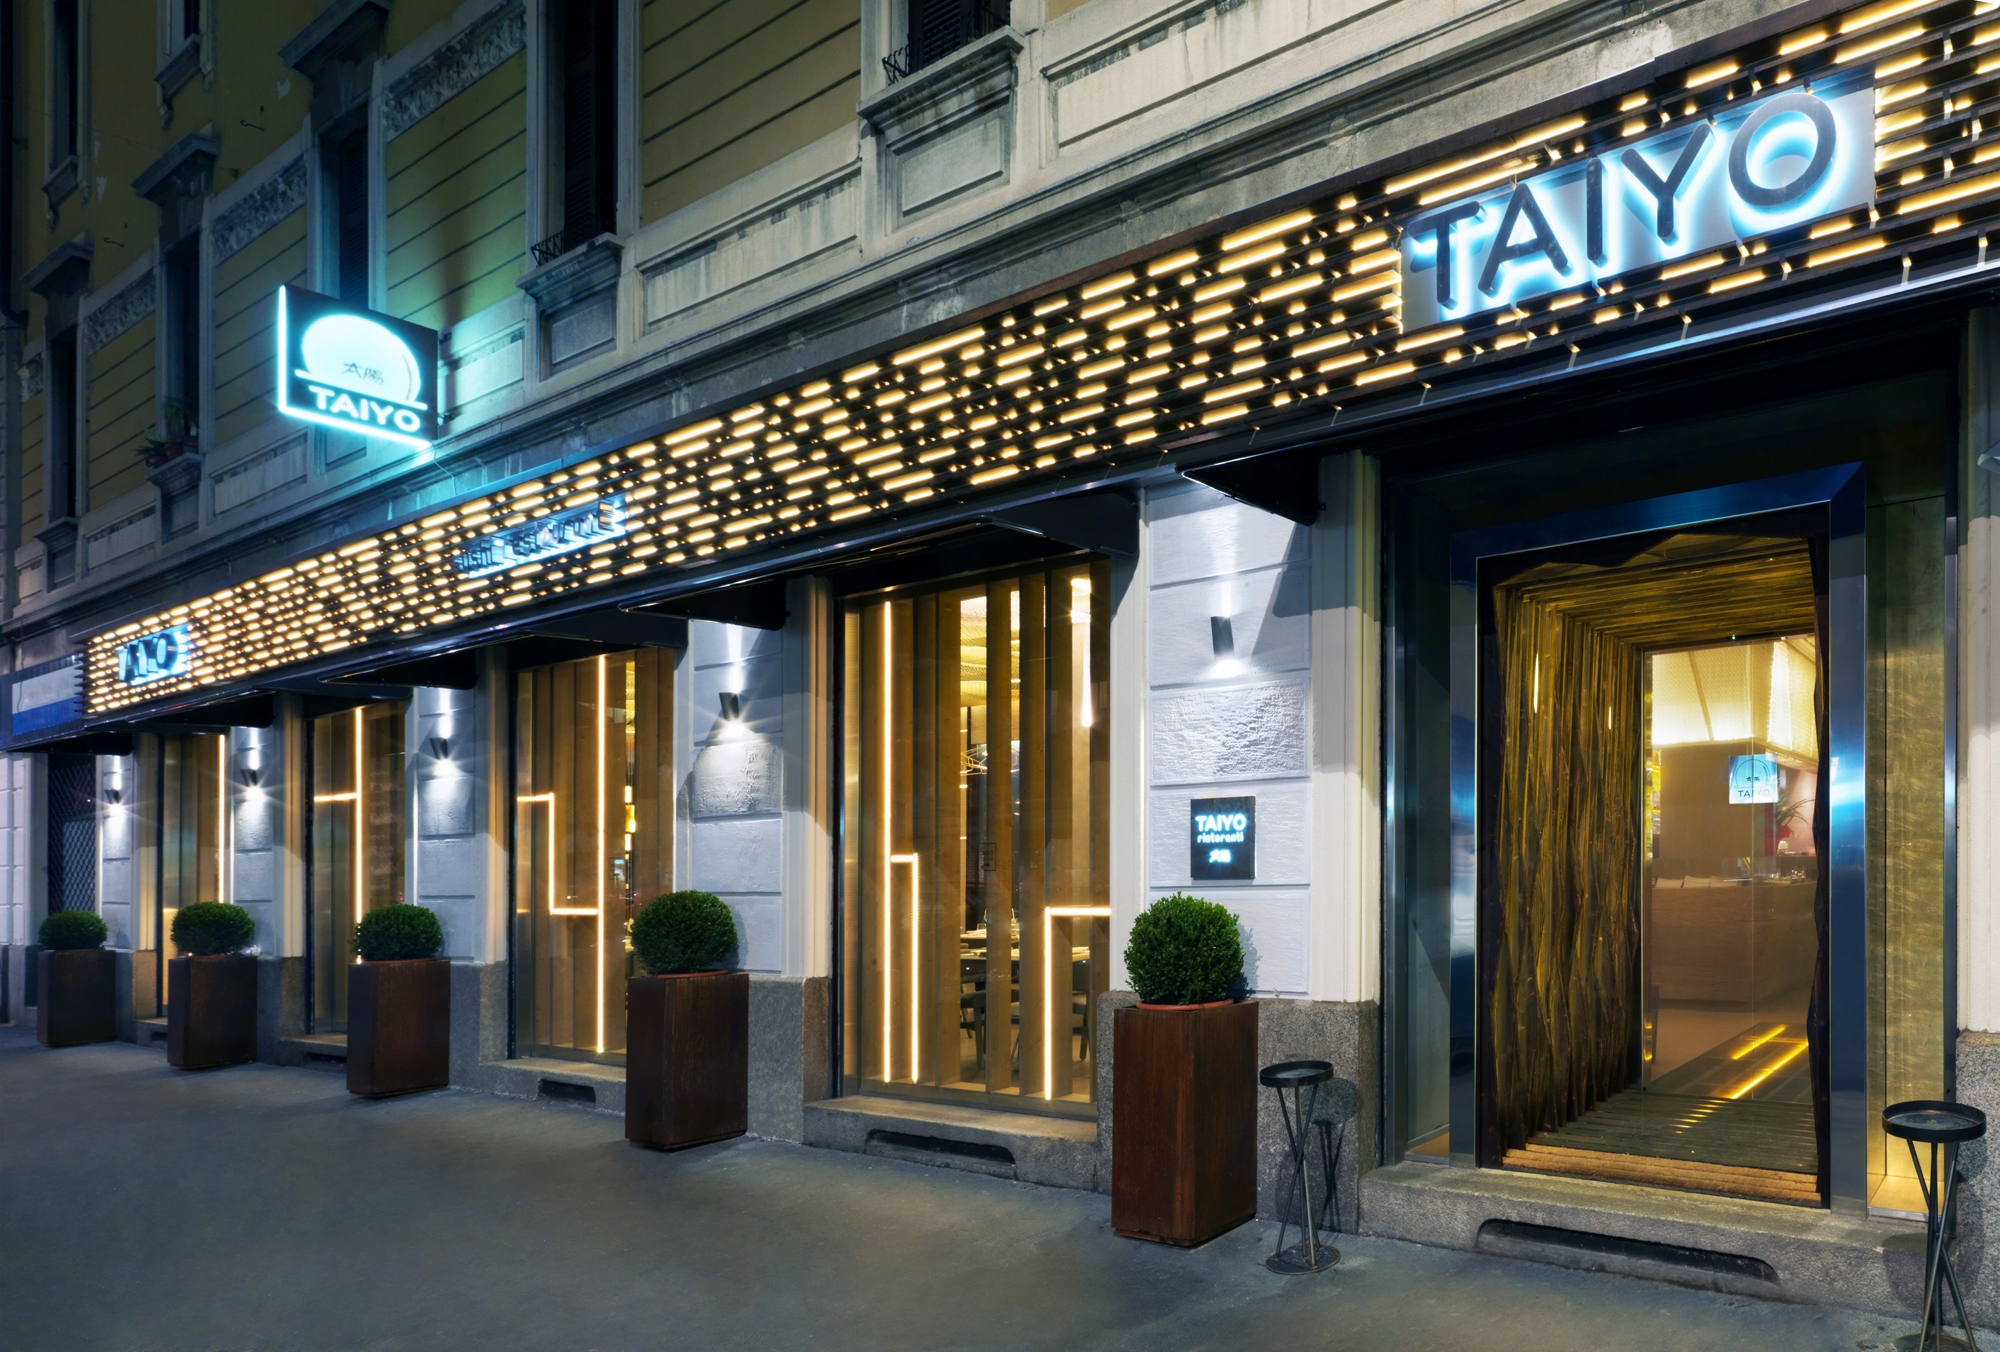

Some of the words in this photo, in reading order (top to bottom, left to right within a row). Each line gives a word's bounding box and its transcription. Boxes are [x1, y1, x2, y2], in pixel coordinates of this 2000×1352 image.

[1407, 92, 1837, 309] TAIYO
[308, 385, 421, 432] TAIYO
[1195, 813, 1247, 832] TAIYO
